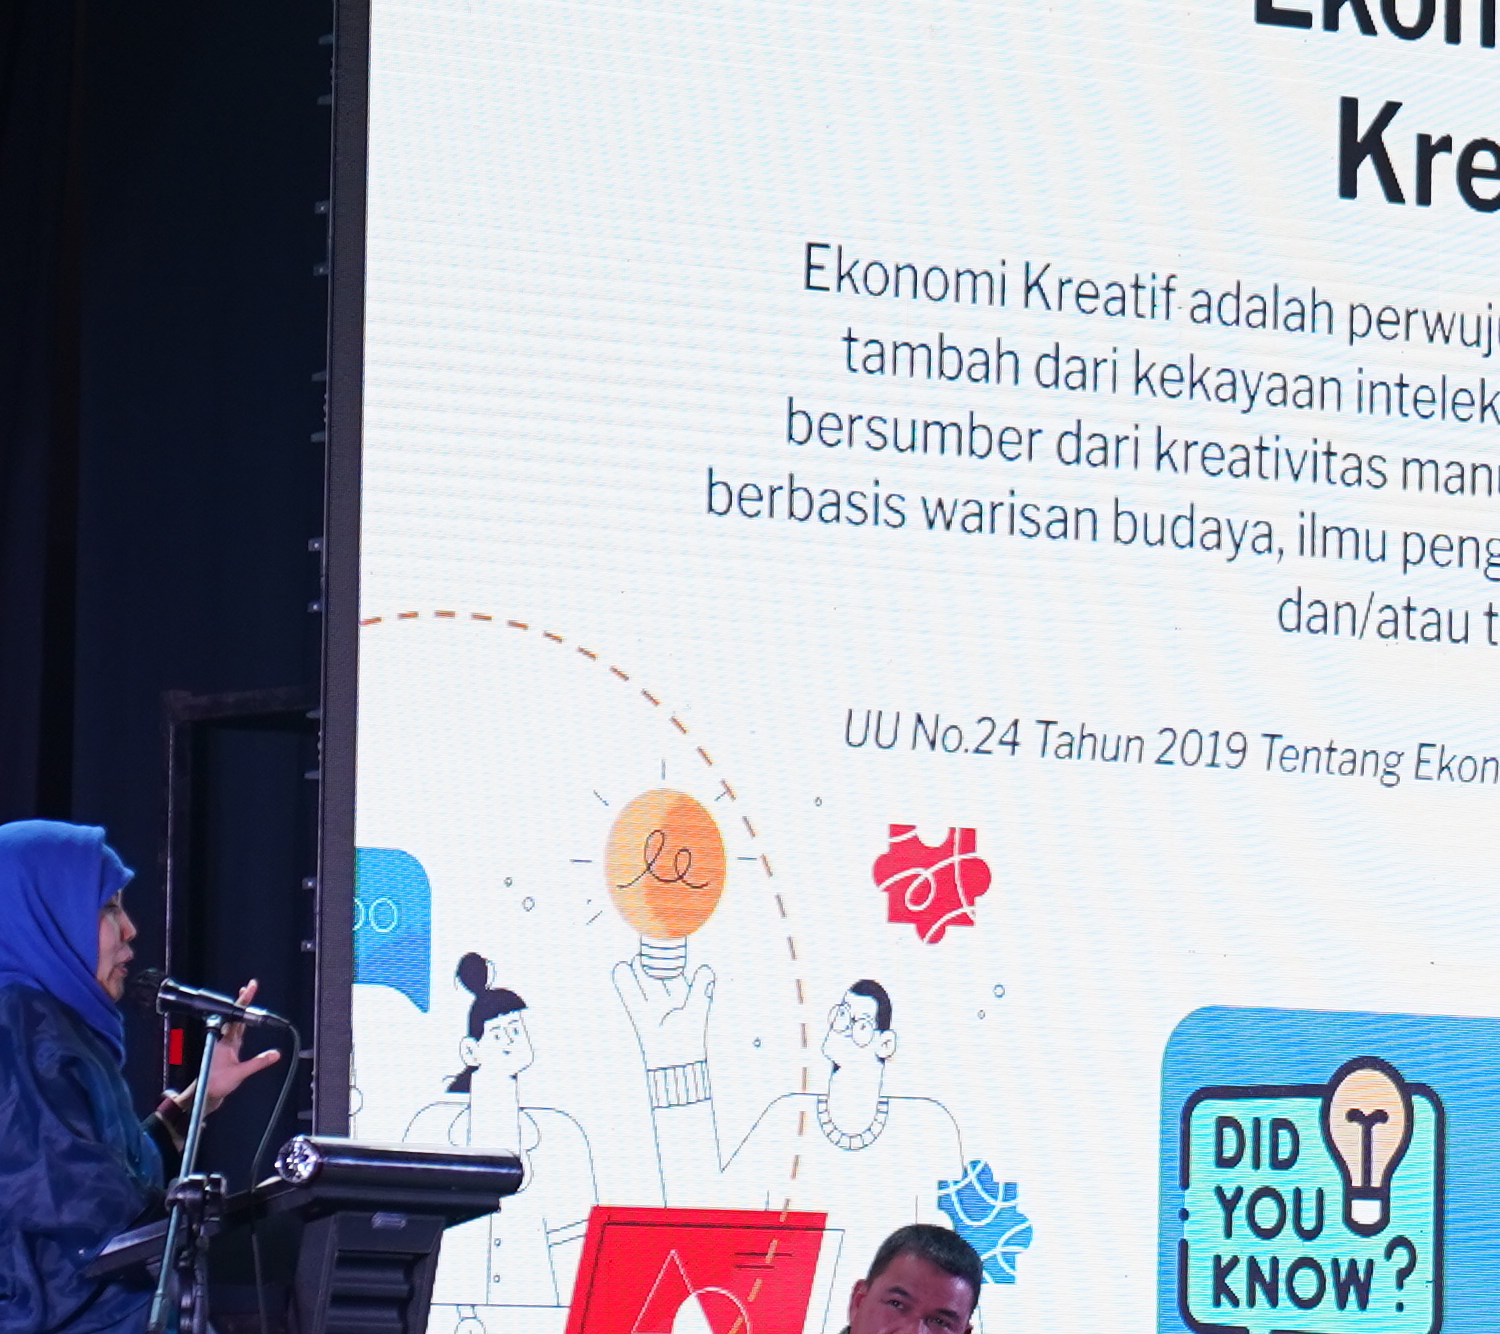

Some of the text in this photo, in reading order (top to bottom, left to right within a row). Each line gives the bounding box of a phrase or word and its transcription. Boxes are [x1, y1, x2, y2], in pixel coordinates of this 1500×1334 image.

[804, 241, 1007, 307] Ekonomi
[1023, 260, 1177, 321] Kreatif
[1189, 279, 1334, 335] adalah
[841, 326, 1020, 386] tambah
[1034, 341, 1118, 394] dari
[1133, 348, 1342, 415] kekayaan
[786, 395, 1044, 463] bersumber
[1056, 418, 1140, 470] dari
[1155, 424, 1388, 490] kreativitas
[706, 466, 907, 530] berbasis
[920, 488, 1098, 542] warisan
[1113, 496, 1285, 563] budaya,
[1298, 510, 1387, 564] ilmu
[1277, 585, 1470, 645] dan/atau
[844, 708, 901, 751] UU
[911, 712, 1021, 756] No.24
[1035, 719, 1145, 764] Tahun
[1154, 726, 1248, 770] 2019
[1261, 732, 1405, 789] Tentang
[1214, 1116, 1299, 1170] DID
[1214, 1185, 1324, 1240] YOU
[1212, 1235, 1417, 1312] KNOW?
